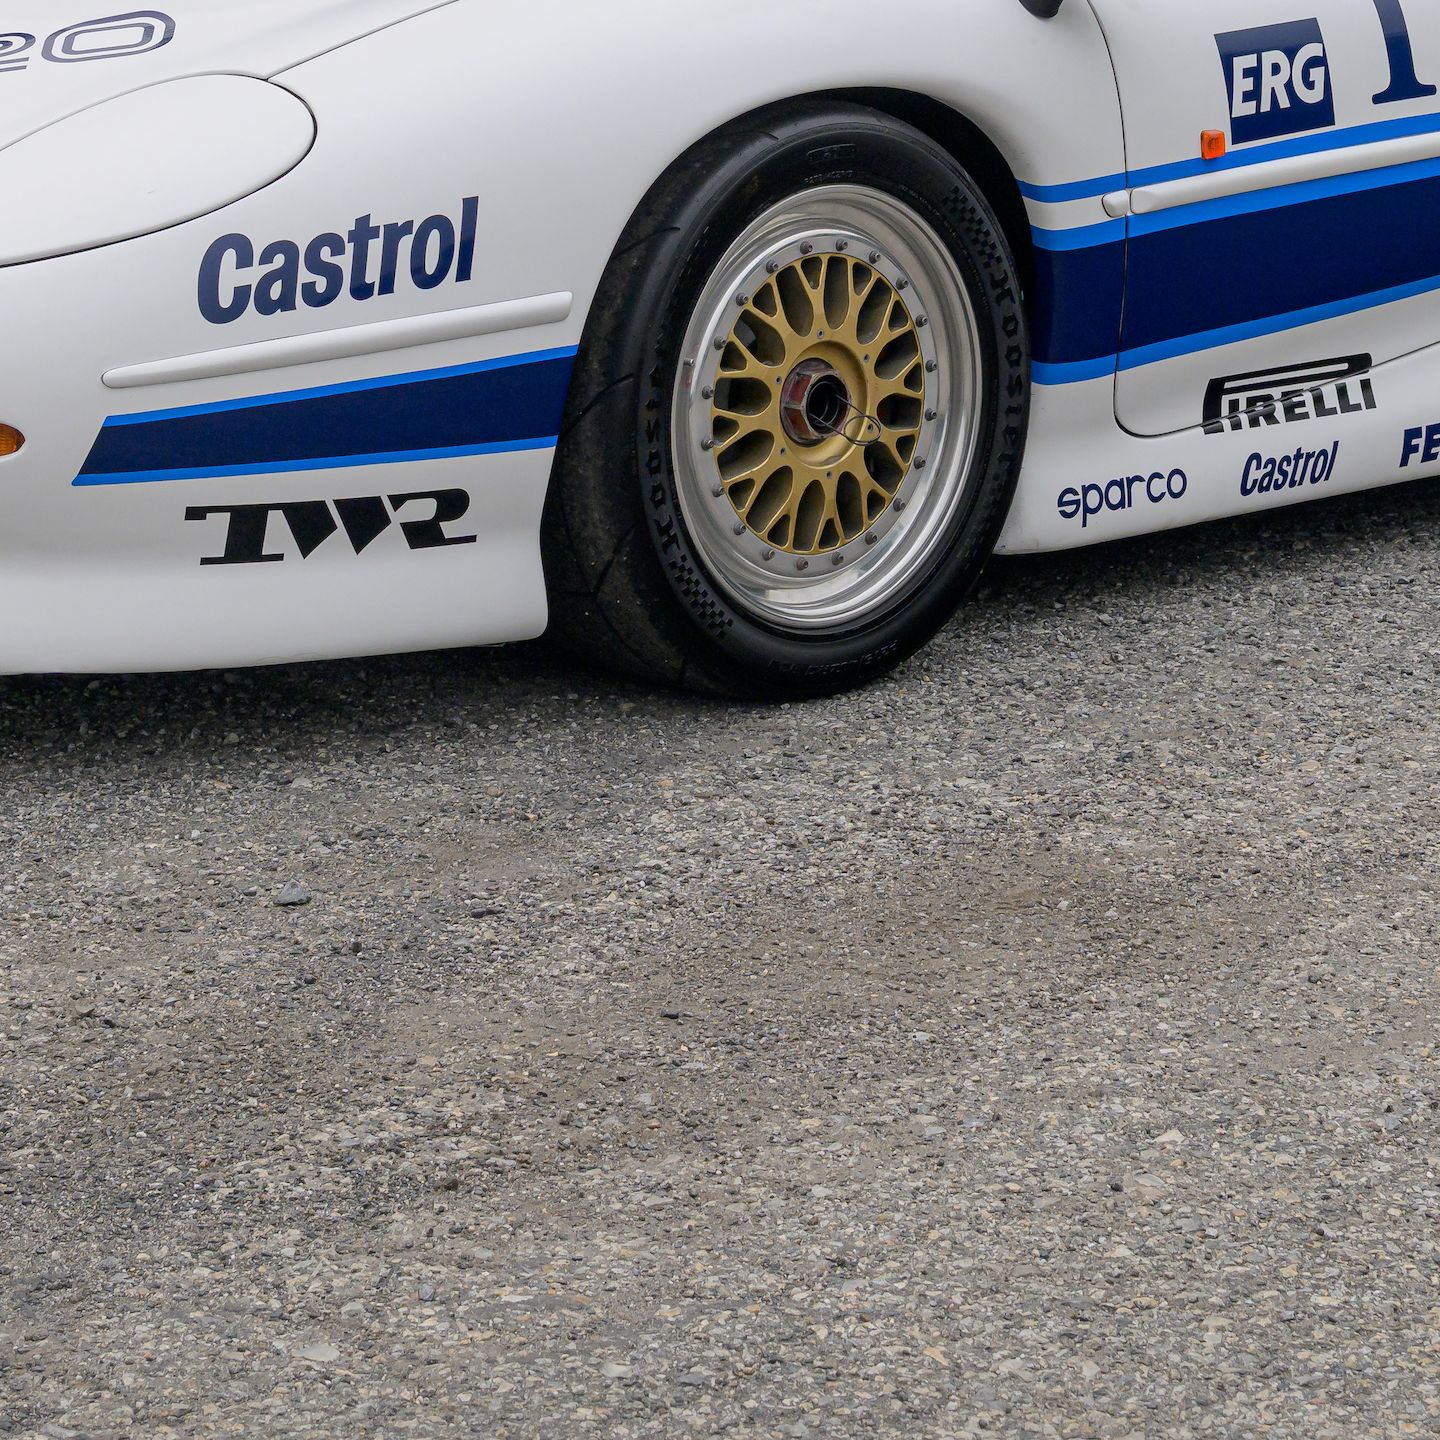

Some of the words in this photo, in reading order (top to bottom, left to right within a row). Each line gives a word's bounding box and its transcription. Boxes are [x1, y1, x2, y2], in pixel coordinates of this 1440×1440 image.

[1231, 42, 1326, 118] ERG
[198, 195, 480, 324] Castrol
[1201, 352, 1377, 435] PIRELLI
[1057, 468, 1188, 528] sparco
[1240, 441, 1339, 496] Castrol
[183, 487, 478, 566] TWR
